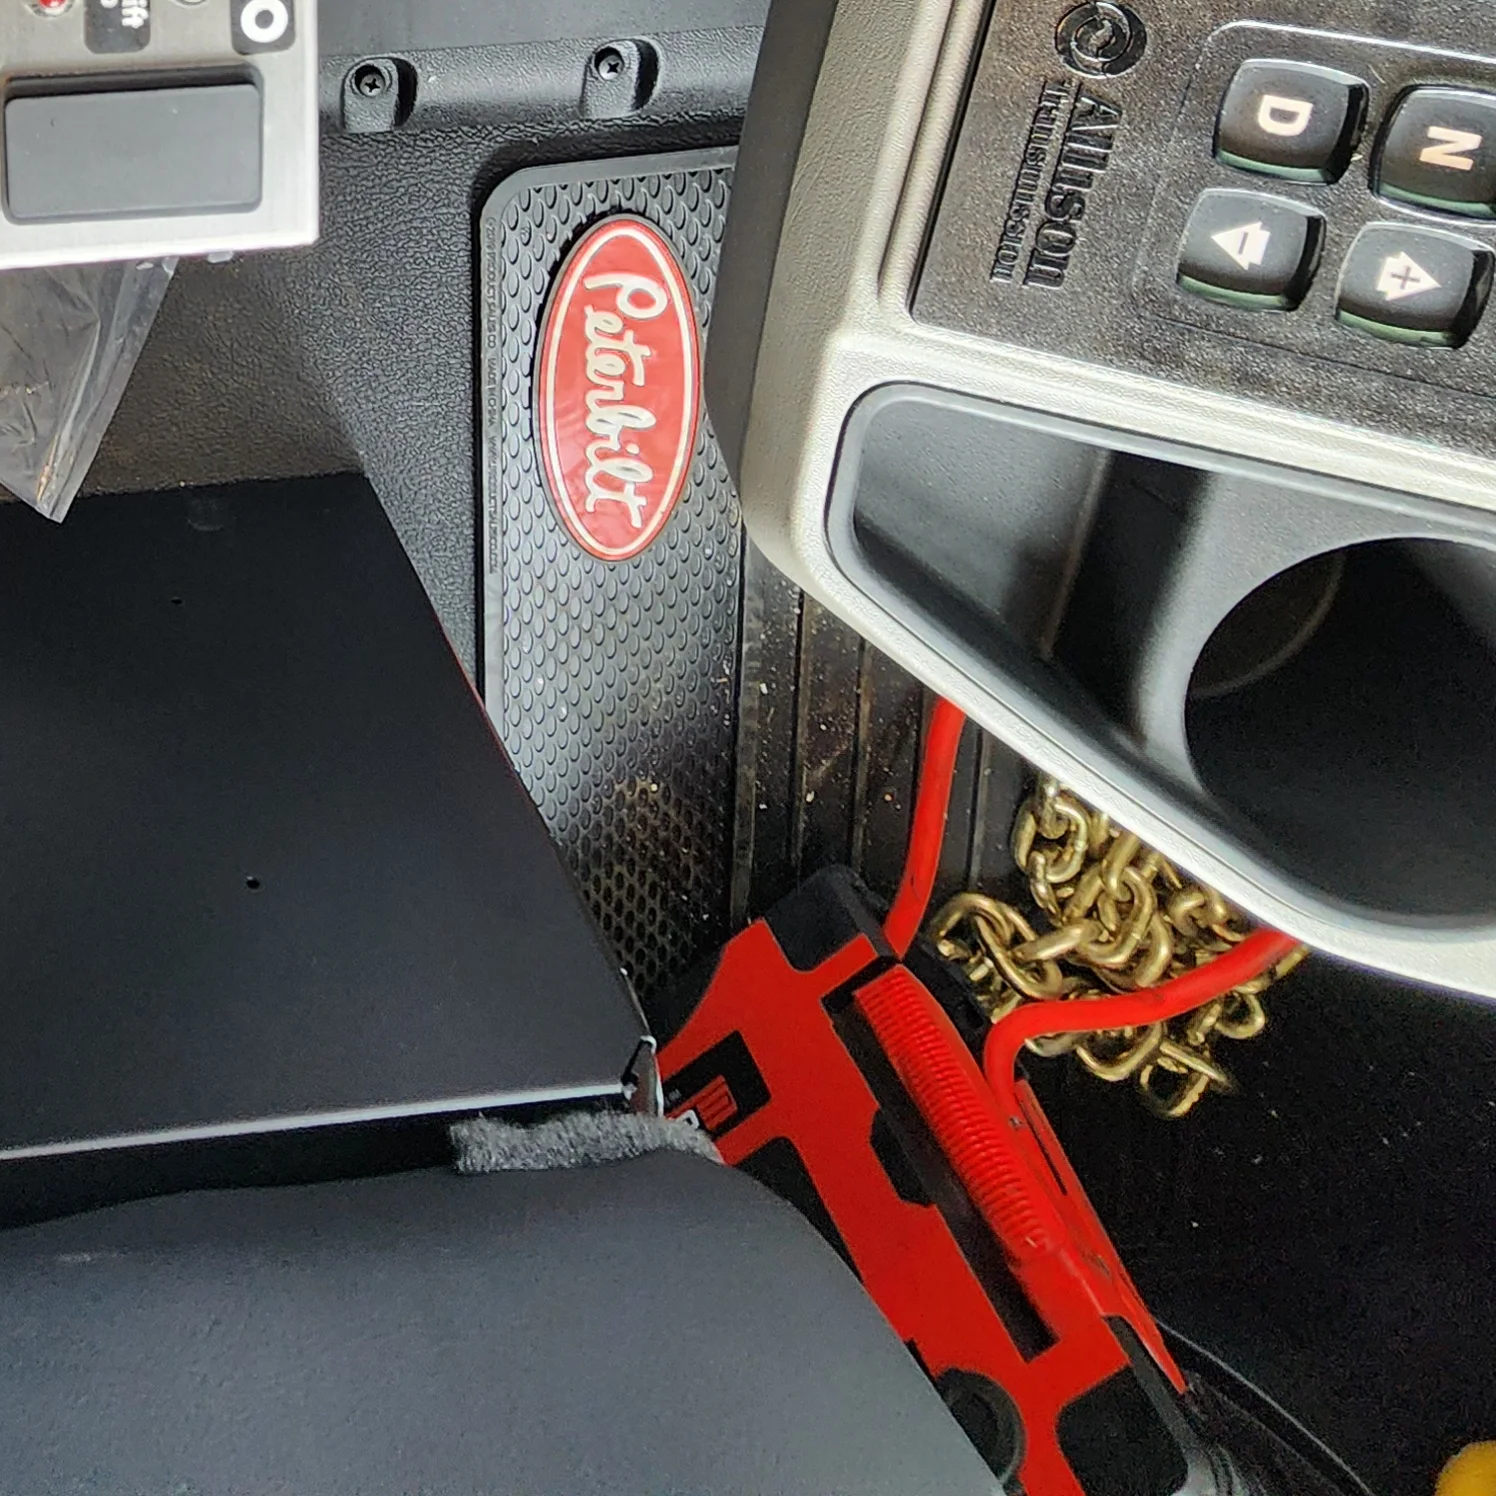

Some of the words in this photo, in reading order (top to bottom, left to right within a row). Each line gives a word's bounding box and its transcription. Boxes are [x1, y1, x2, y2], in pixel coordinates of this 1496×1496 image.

[990, 80, 1070, 284] Transmission
[1023, 89, 1122, 290] Allison
[1257, 94, 1313, 137] D
[1419, 125, 1483, 171] N
[584, 272, 668, 529] Peterbilt
